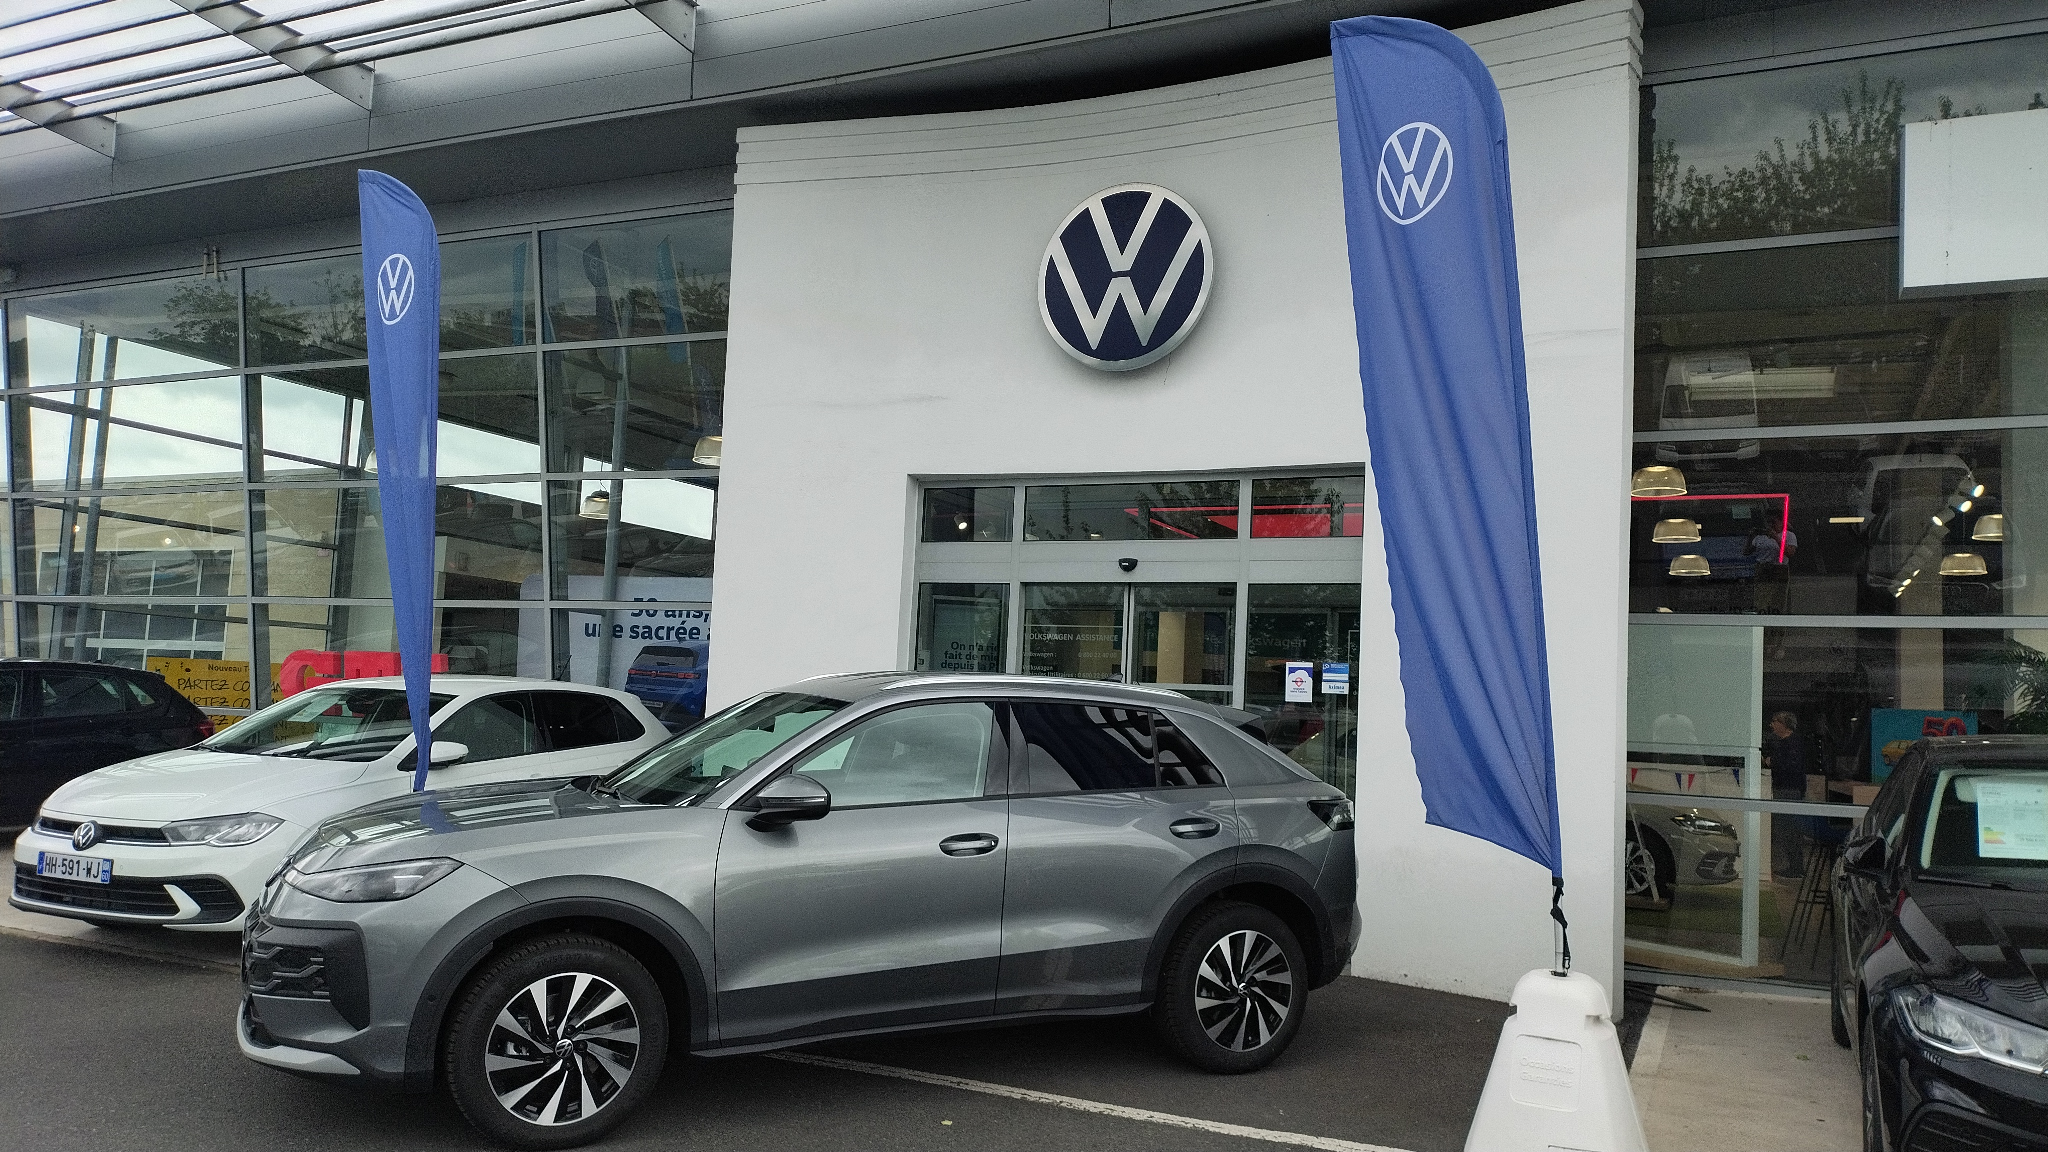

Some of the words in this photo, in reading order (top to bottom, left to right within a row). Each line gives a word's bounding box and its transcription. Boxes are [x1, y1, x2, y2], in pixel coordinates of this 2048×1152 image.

[584, 622, 624, 639] ue
[629, 620, 700, 640] sacrée
[951, 641, 966, 651] On
[969, 642, 984, 652] n'a
[944, 650, 962, 660] fait
[966, 651, 978, 661] de
[207, 664, 241, 672] Nouveau
[941, 659, 974, 671] depuis
[177, 677, 229, 691] PARTEZ
[45, 855, 101, 879] HH-591-WJ
[1520, 1057, 1575, 1075] Occasions
[1520, 1071, 1573, 1089] Garanties
